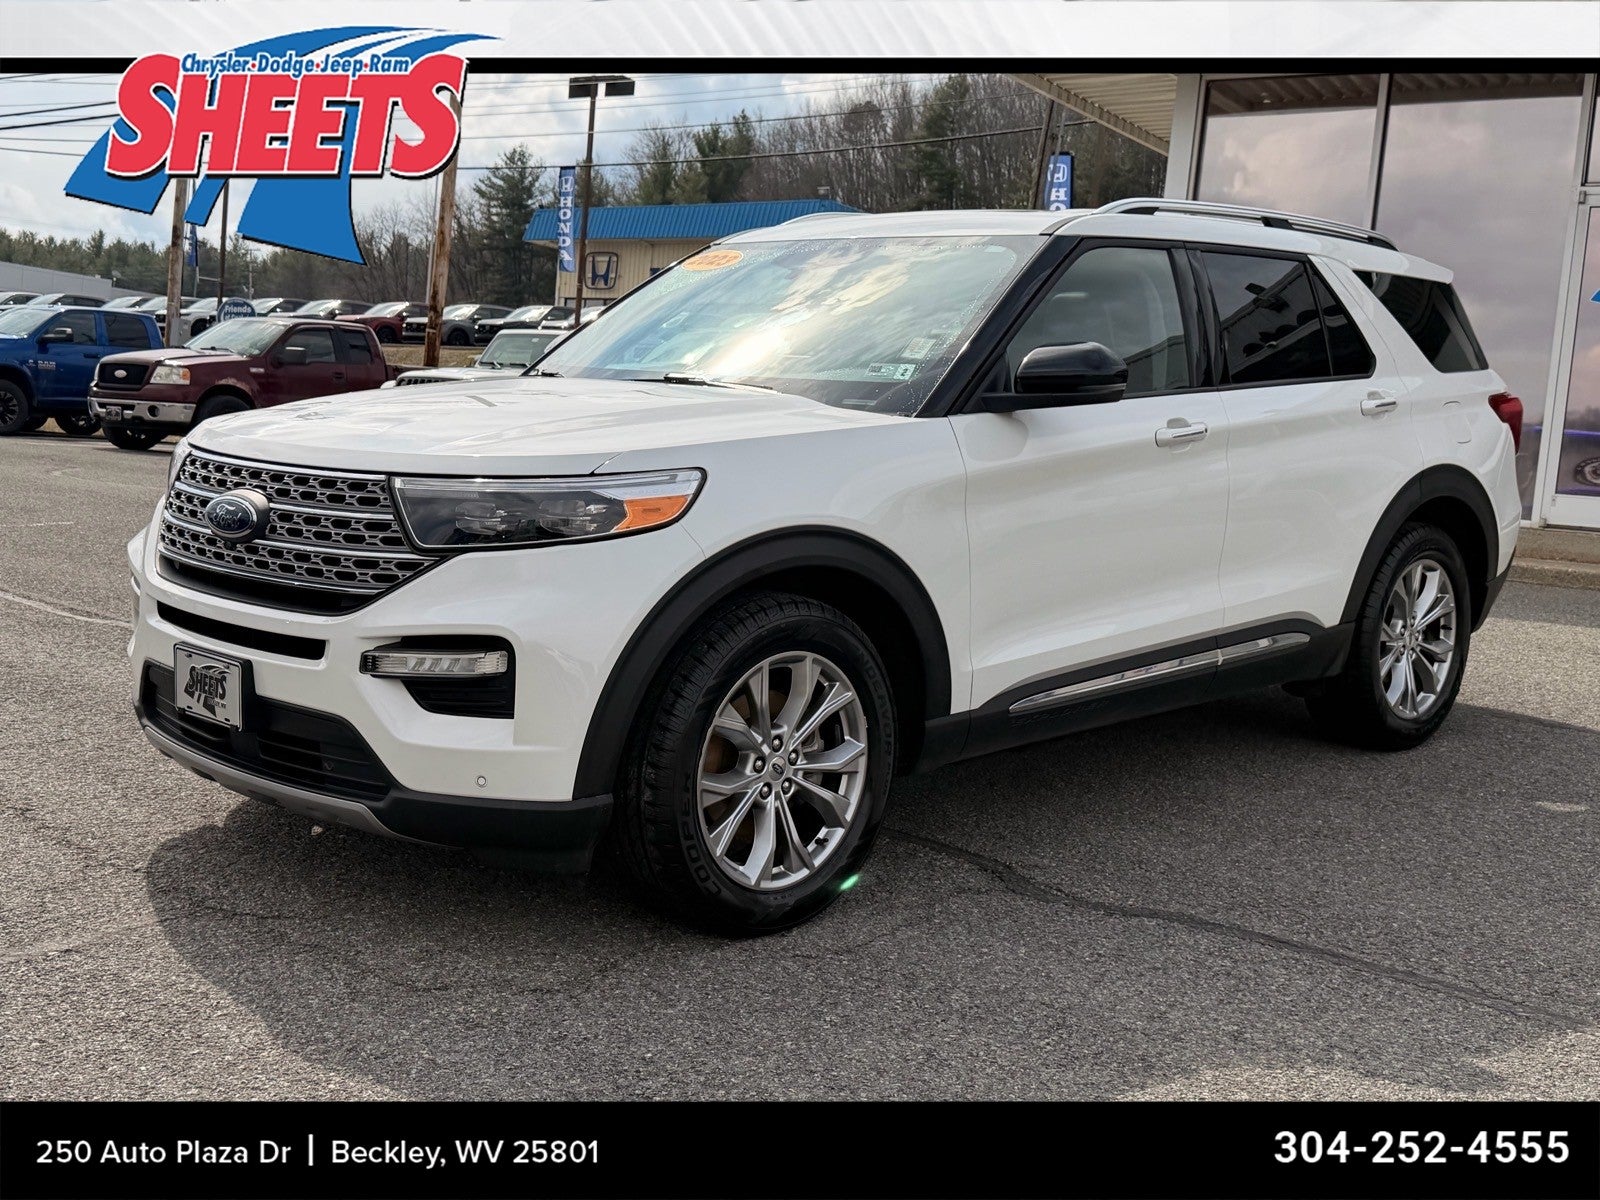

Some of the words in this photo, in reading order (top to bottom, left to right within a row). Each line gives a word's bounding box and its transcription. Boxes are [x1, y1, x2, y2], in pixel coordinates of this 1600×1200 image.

[558, 195, 573, 261] HONDA
[225, 304, 252, 313] Friends
[213, 503, 242, 523] Ford
[188, 665, 227, 701] SHEETS
